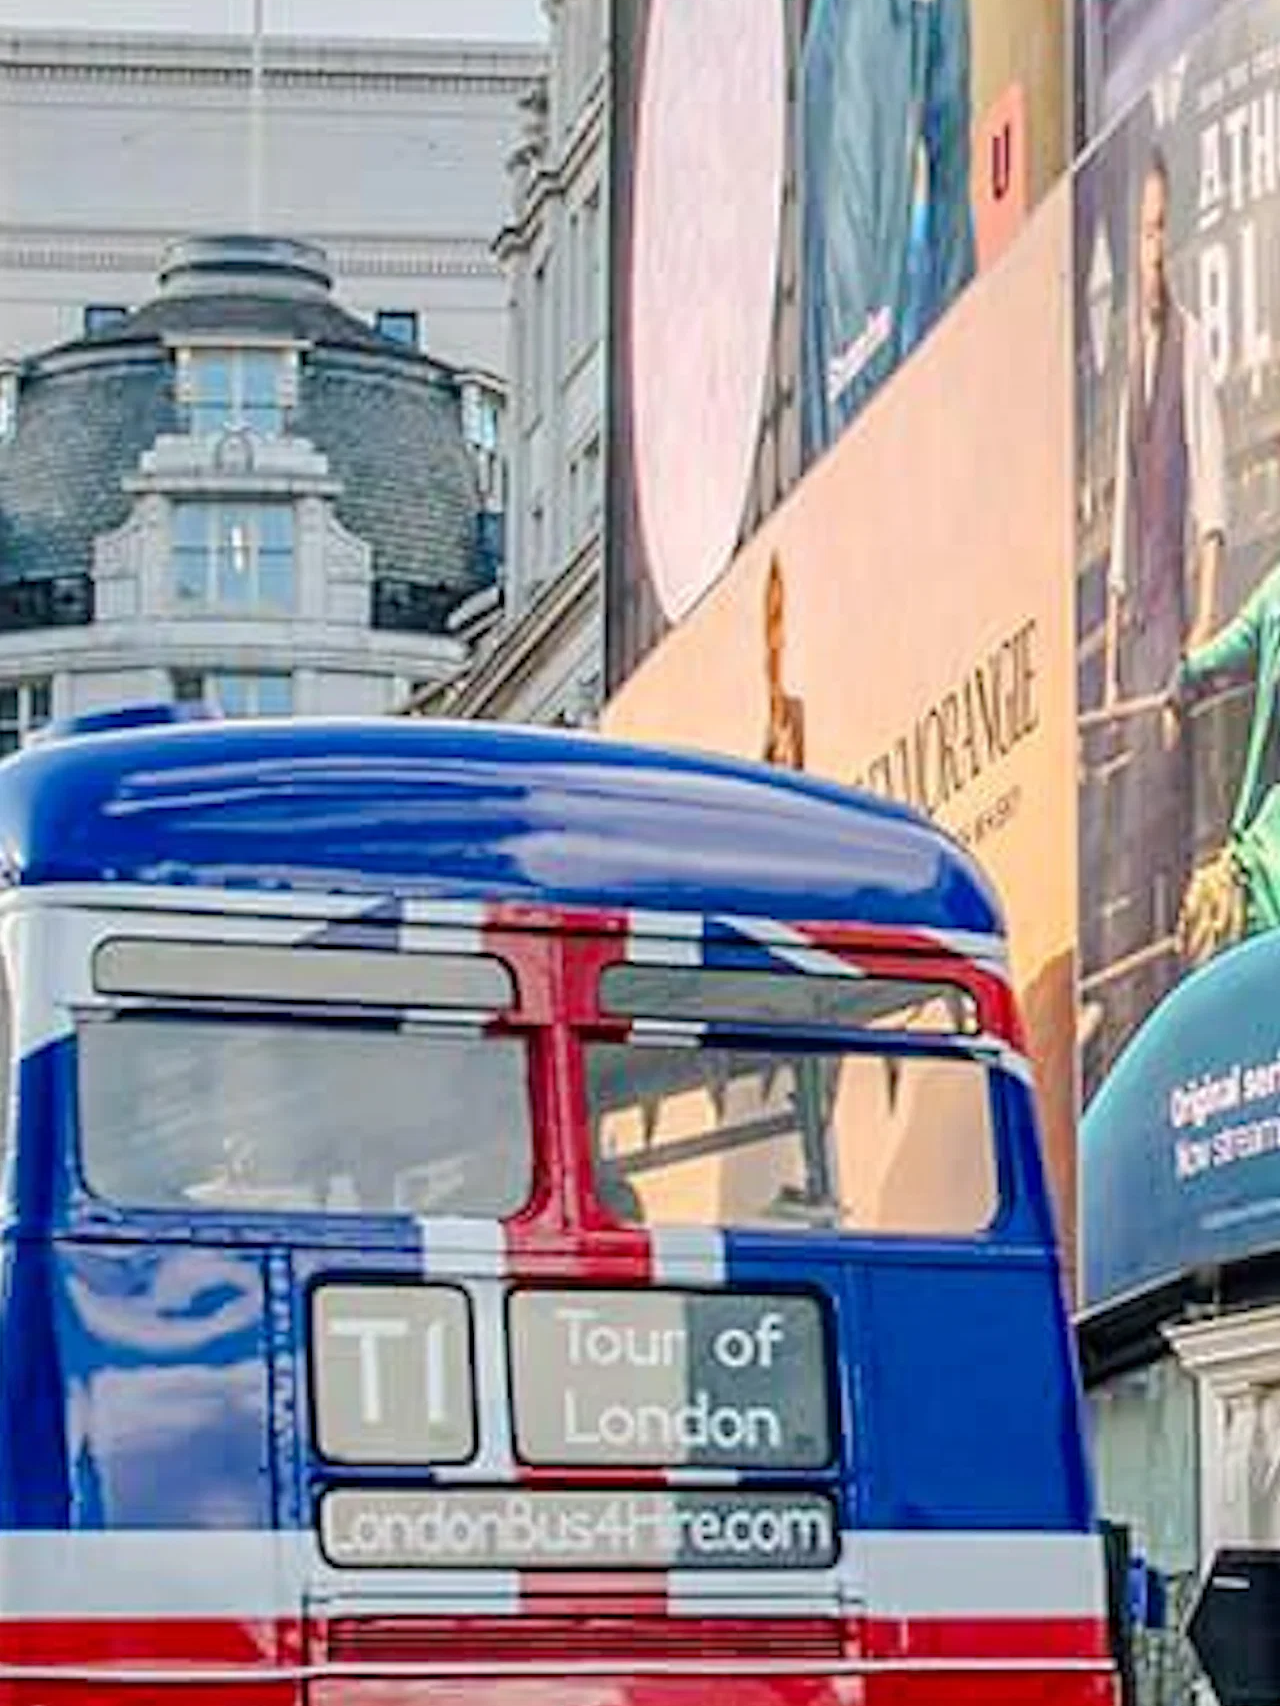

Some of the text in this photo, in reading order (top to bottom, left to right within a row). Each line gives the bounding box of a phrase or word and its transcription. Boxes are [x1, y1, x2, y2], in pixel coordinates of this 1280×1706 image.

[557, 1309, 785, 1369] Tour of
[564, 1391, 783, 1449] London
[326, 1496, 832, 1555] LondonBus4Hire.com
